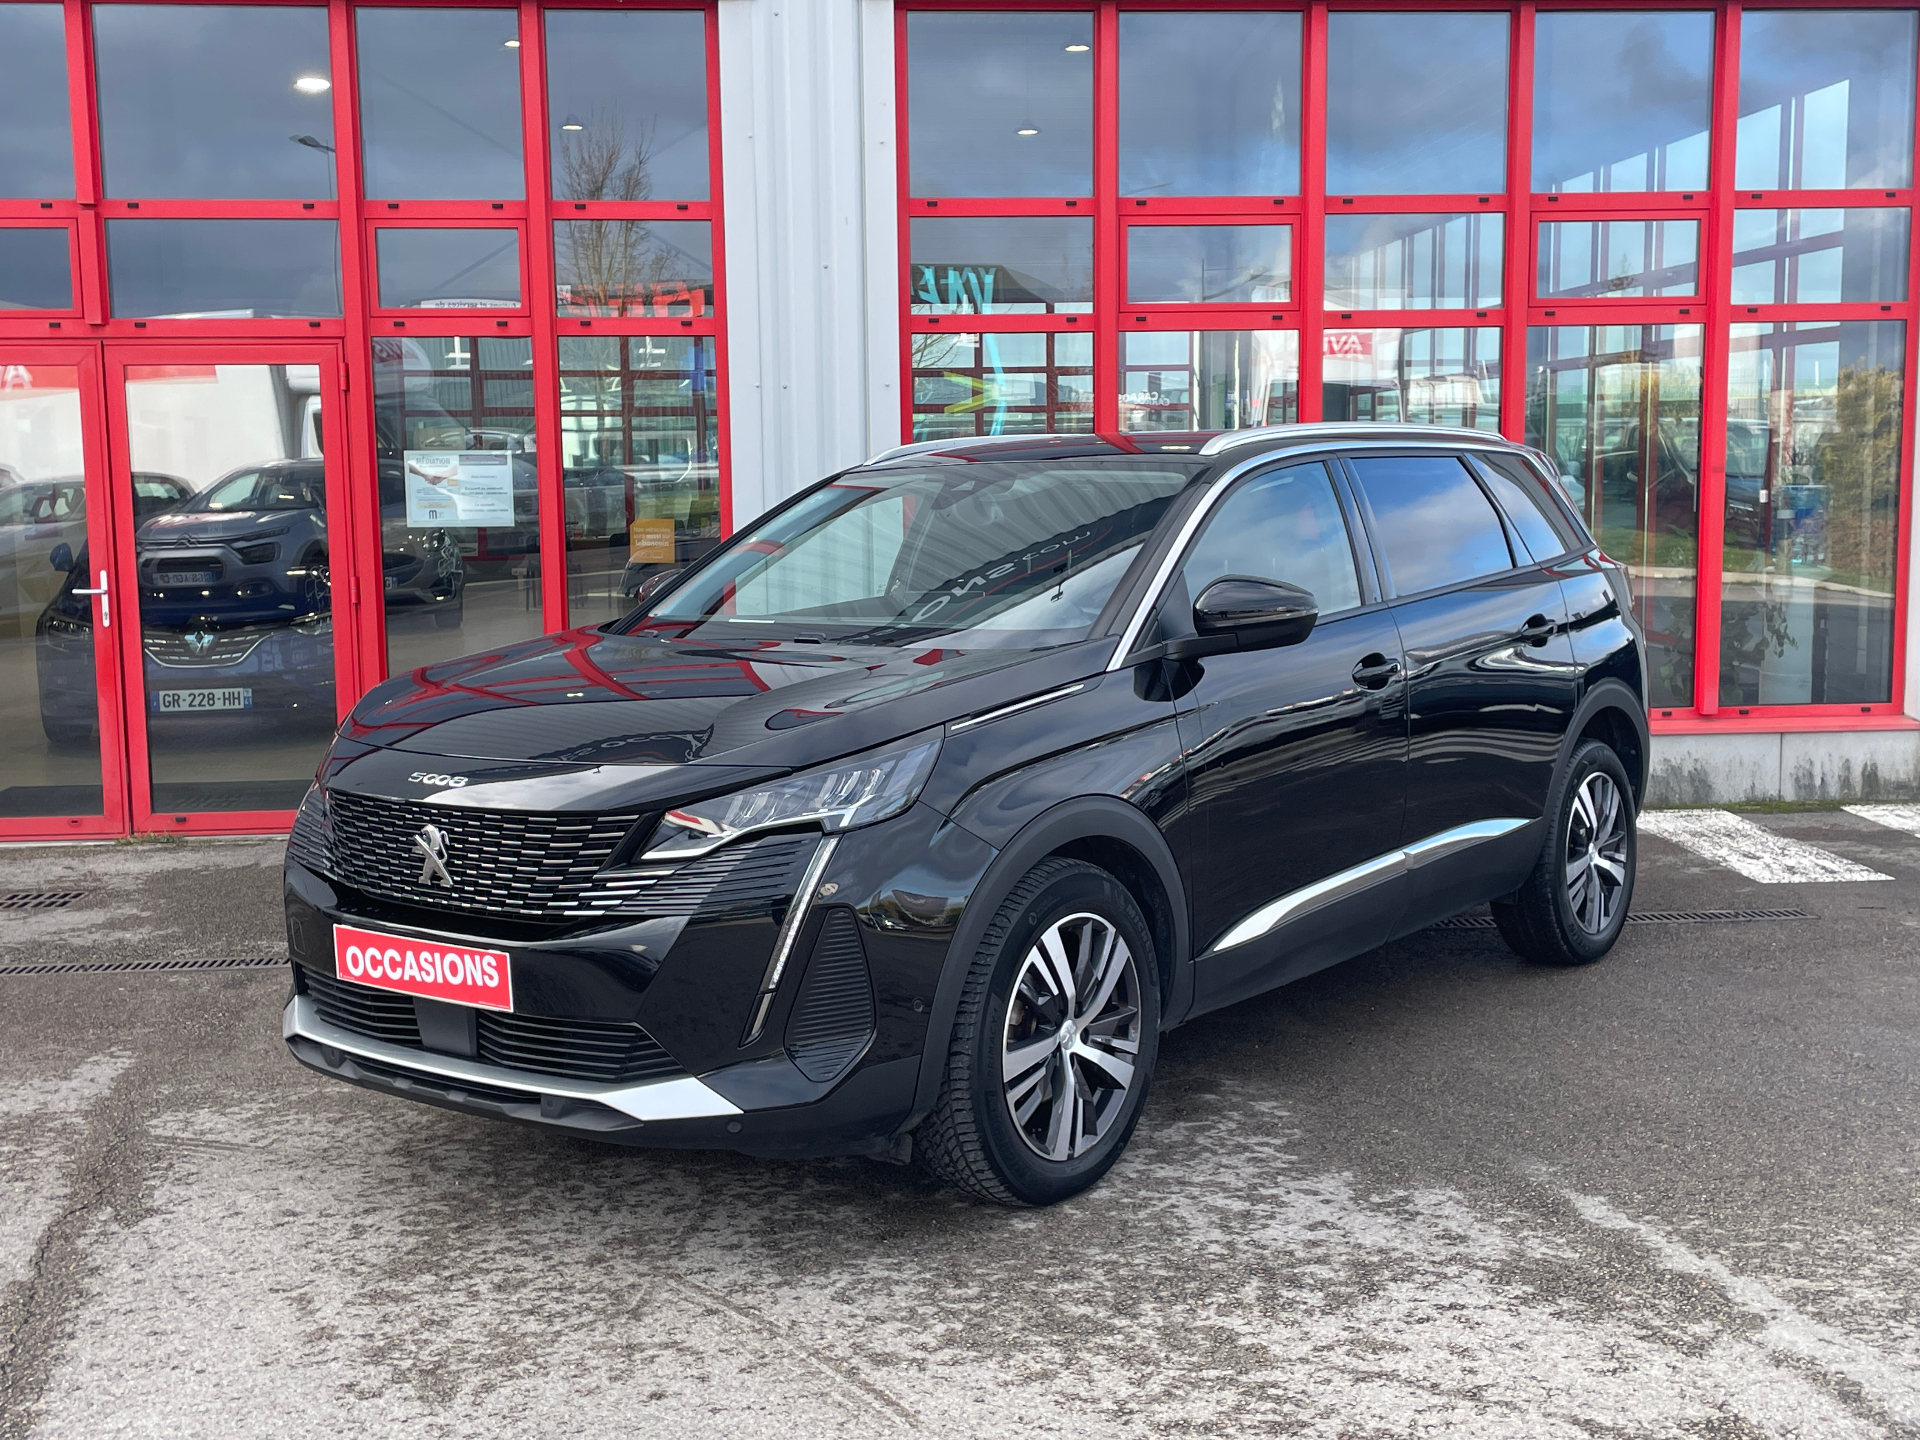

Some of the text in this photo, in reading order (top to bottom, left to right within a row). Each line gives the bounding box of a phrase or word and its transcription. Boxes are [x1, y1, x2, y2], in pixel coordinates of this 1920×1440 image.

[162, 690, 241, 708] GR-228-HH
[408, 771, 469, 788] 5008
[345, 945, 500, 988] OCCASIONS
